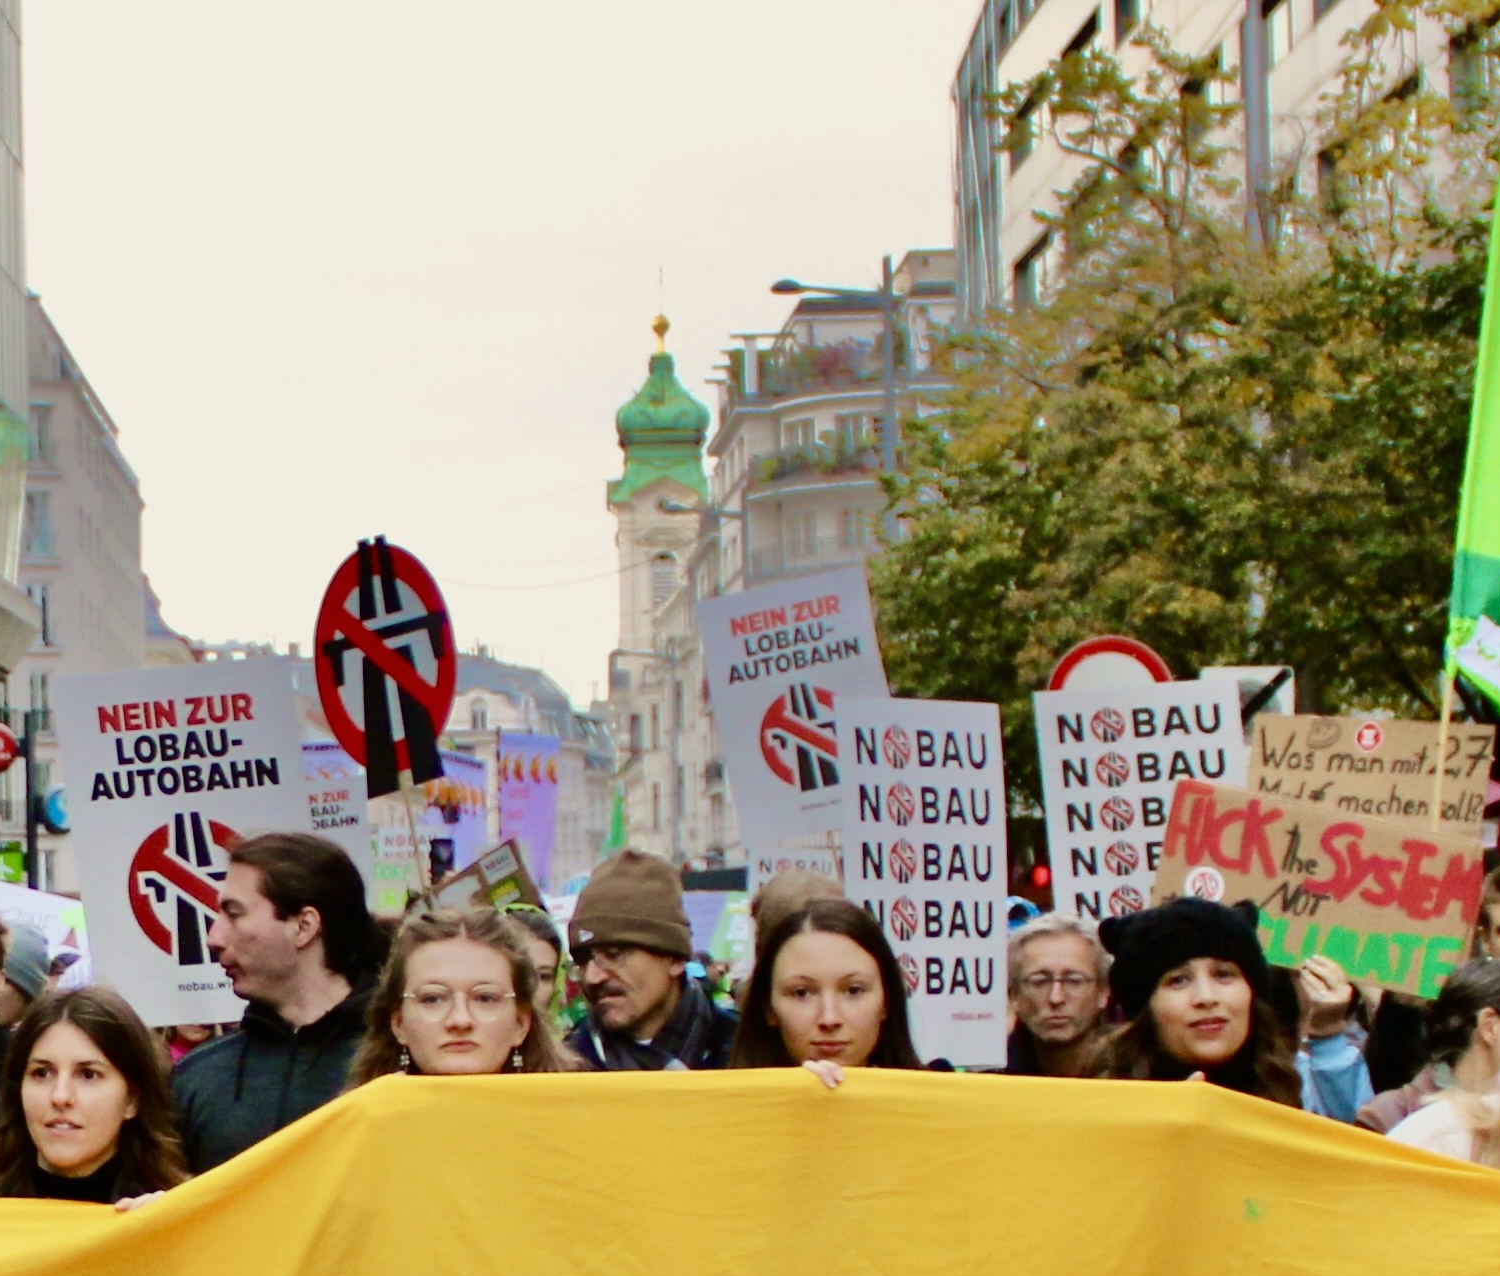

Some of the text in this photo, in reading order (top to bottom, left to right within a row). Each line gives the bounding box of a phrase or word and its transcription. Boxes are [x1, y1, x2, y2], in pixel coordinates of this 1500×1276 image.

[730, 595, 842, 637] NEIN ZUR
[744, 620, 836, 657] LOBAU-
[728, 636, 862, 685] AUTOBAHN
[97, 693, 254, 734] NEIN ZUR
[115, 729, 243, 765] LOBAU-
[1259, 726, 1315, 771] Was
[1326, 750, 1384, 774] man
[1389, 744, 1427, 775] mit
[91, 757, 281, 801] AUTOBAHN
[322, 789, 350, 803] ZUR
[310, 804, 345, 818] BAU-
[1337, 783, 1429, 816] machen
[1162, 779, 1484, 926] FUCK the SYSTEM
[1259, 881, 1331, 917] NOT
